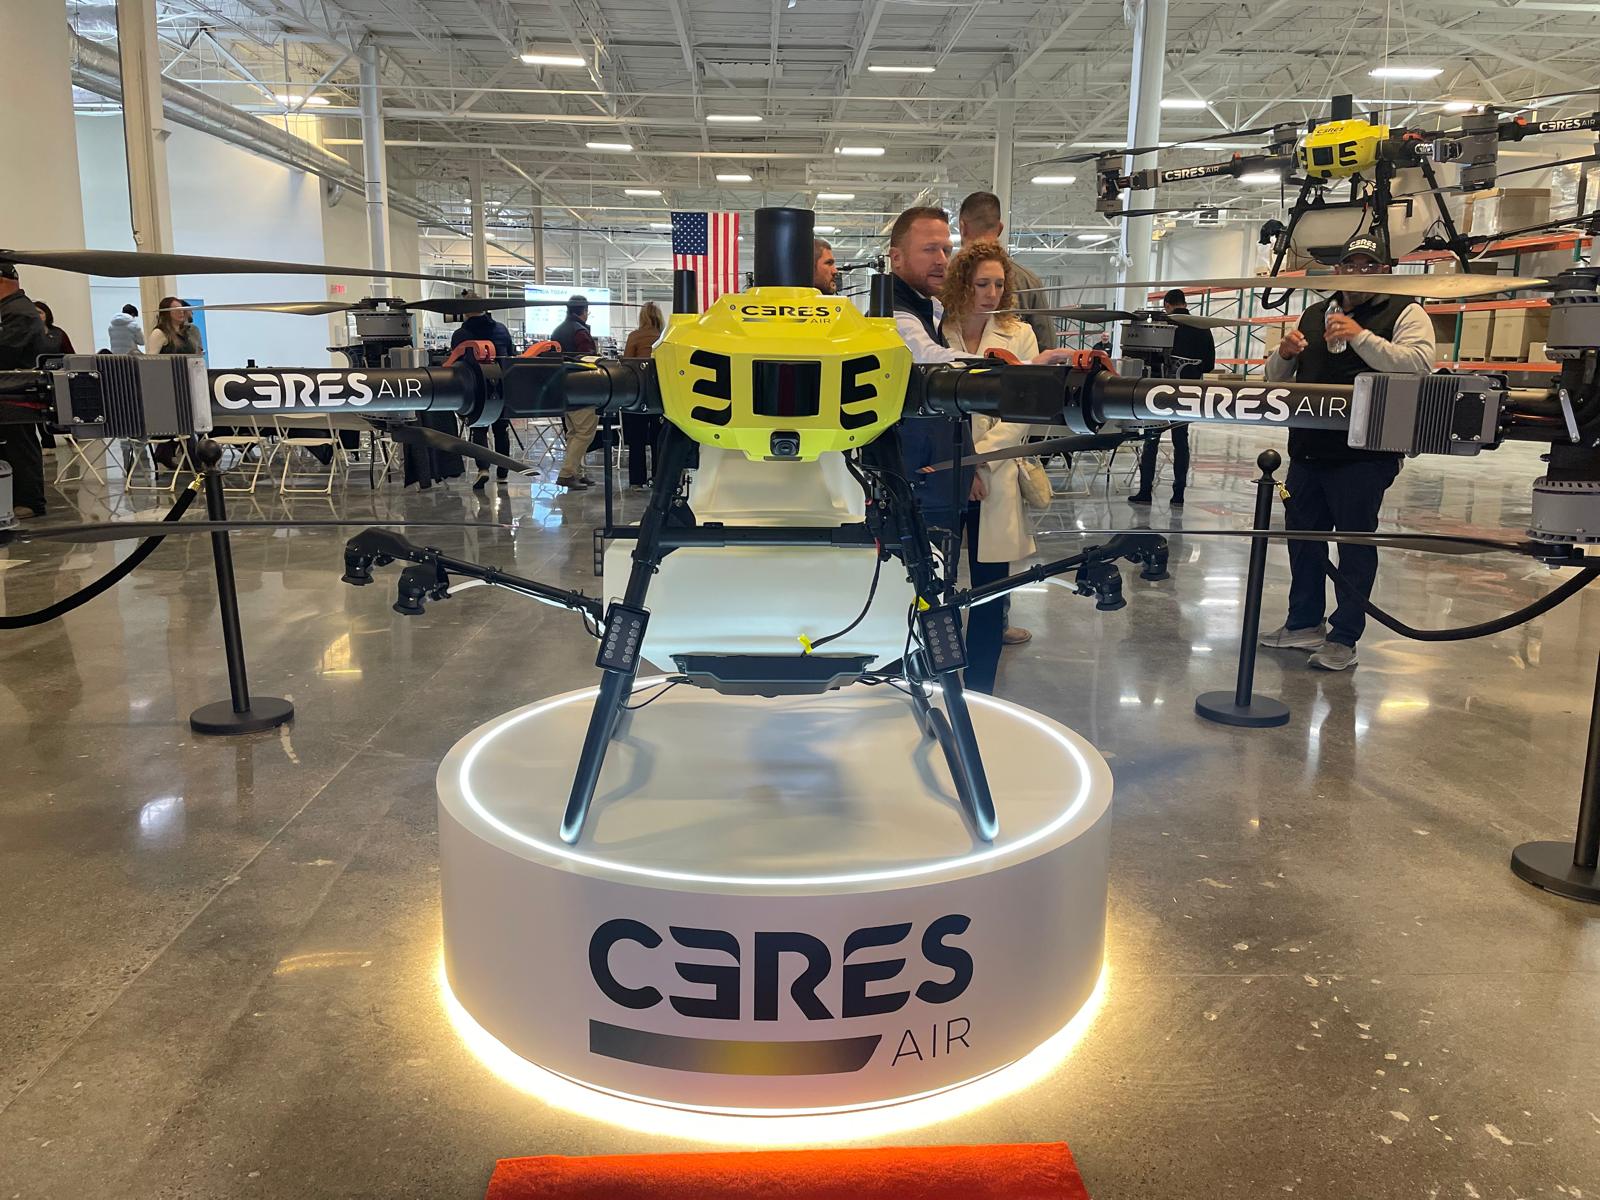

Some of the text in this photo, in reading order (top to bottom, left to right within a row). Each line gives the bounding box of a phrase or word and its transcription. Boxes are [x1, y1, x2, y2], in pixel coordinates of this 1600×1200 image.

[1539, 119, 1596, 132] CERES AIR
[1165, 166, 1220, 180] CERES AIR
[741, 305, 830, 317] CERES
[213, 372, 423, 410] CERES AIR
[1145, 384, 1347, 422] CERES AIR
[588, 913, 974, 1021] CERES
[891, 1016, 972, 1067] AIR
